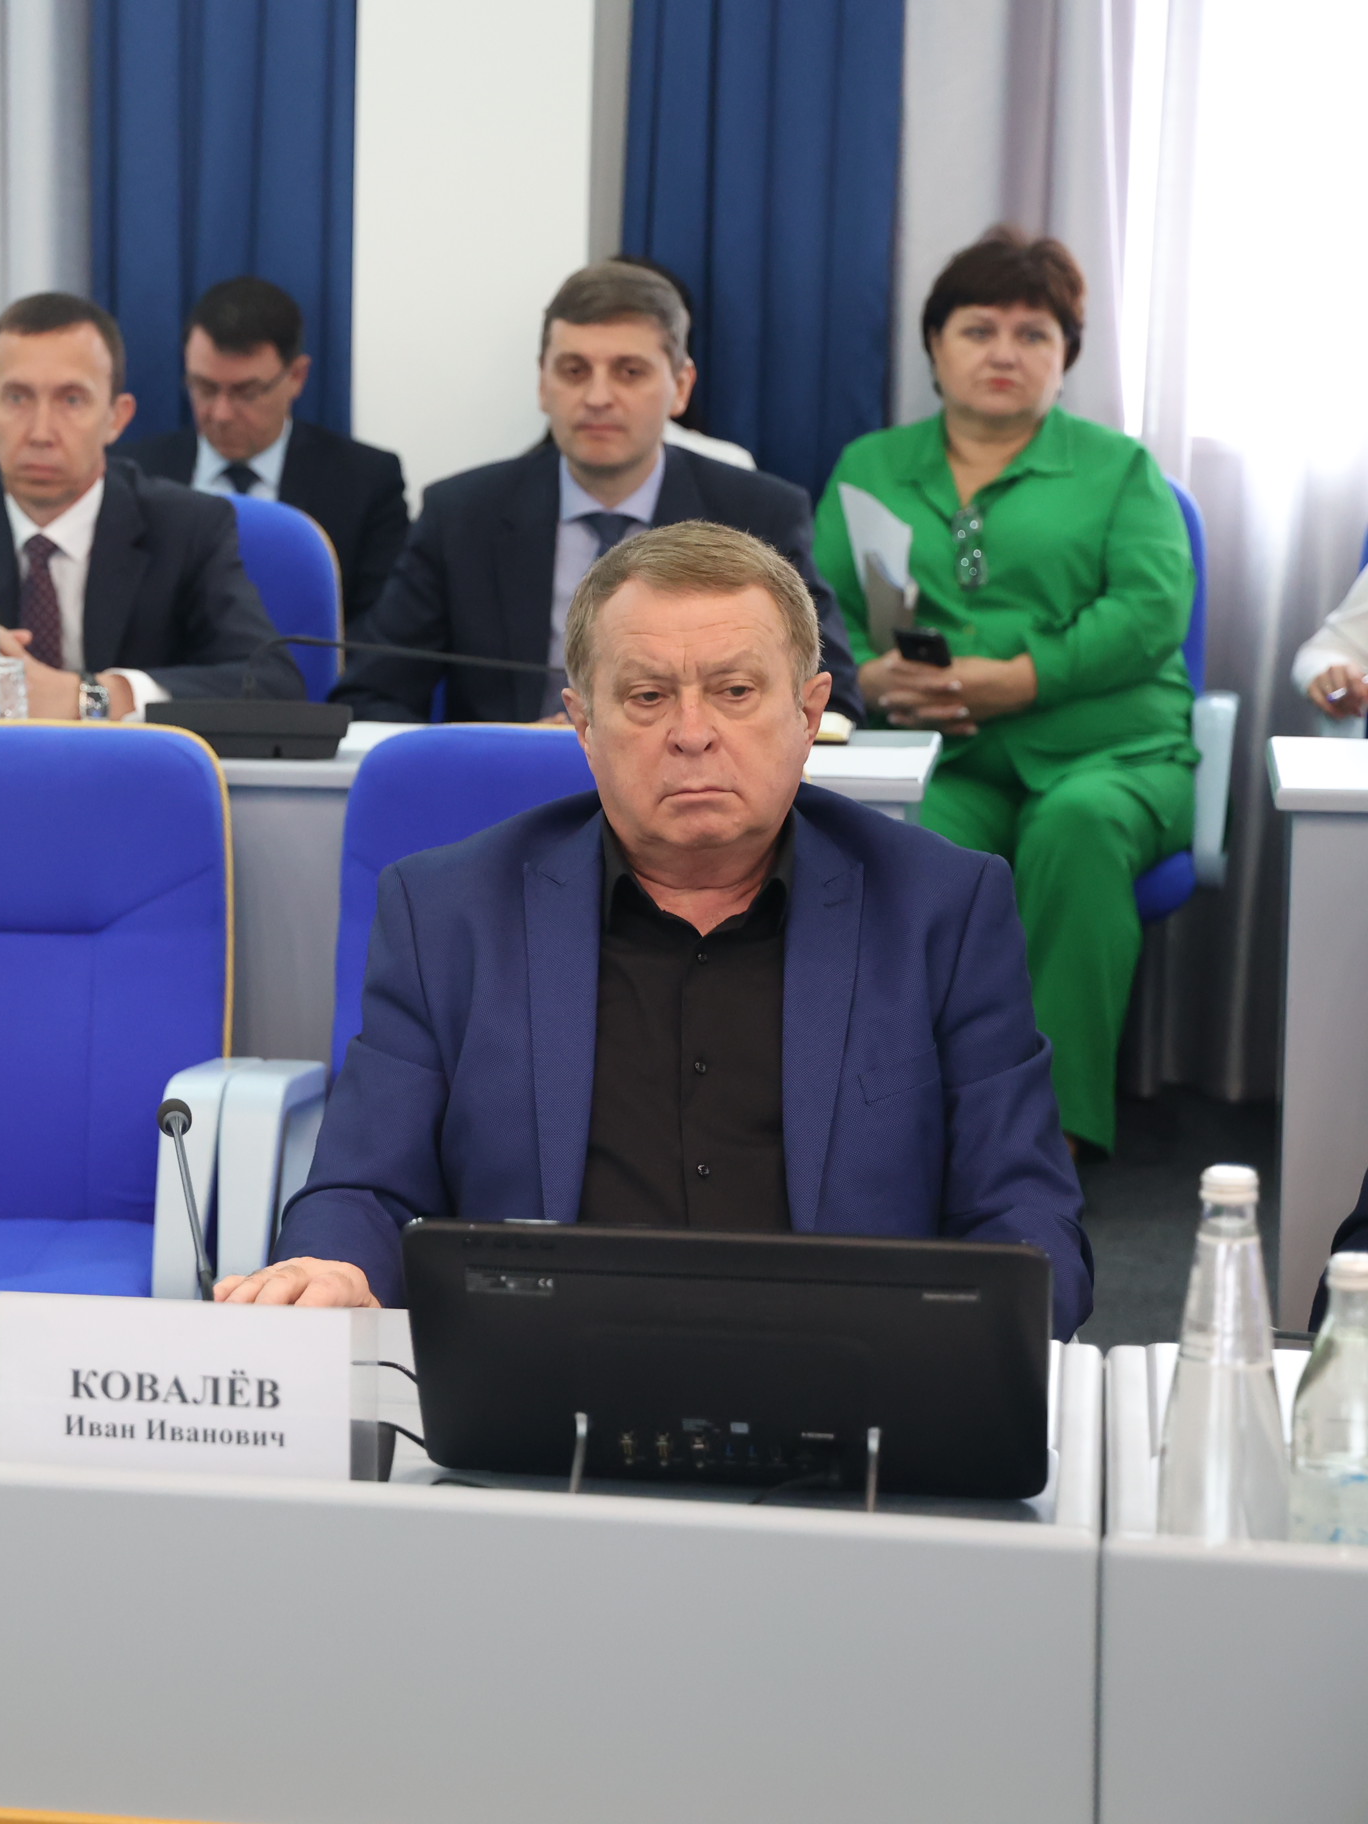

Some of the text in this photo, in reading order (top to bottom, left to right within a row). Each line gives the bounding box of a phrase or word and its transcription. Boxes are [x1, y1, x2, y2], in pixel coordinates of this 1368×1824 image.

[70, 1368, 281, 1409] КОВАЛЁВ
[65, 1414, 286, 1447] Иван Иванович
